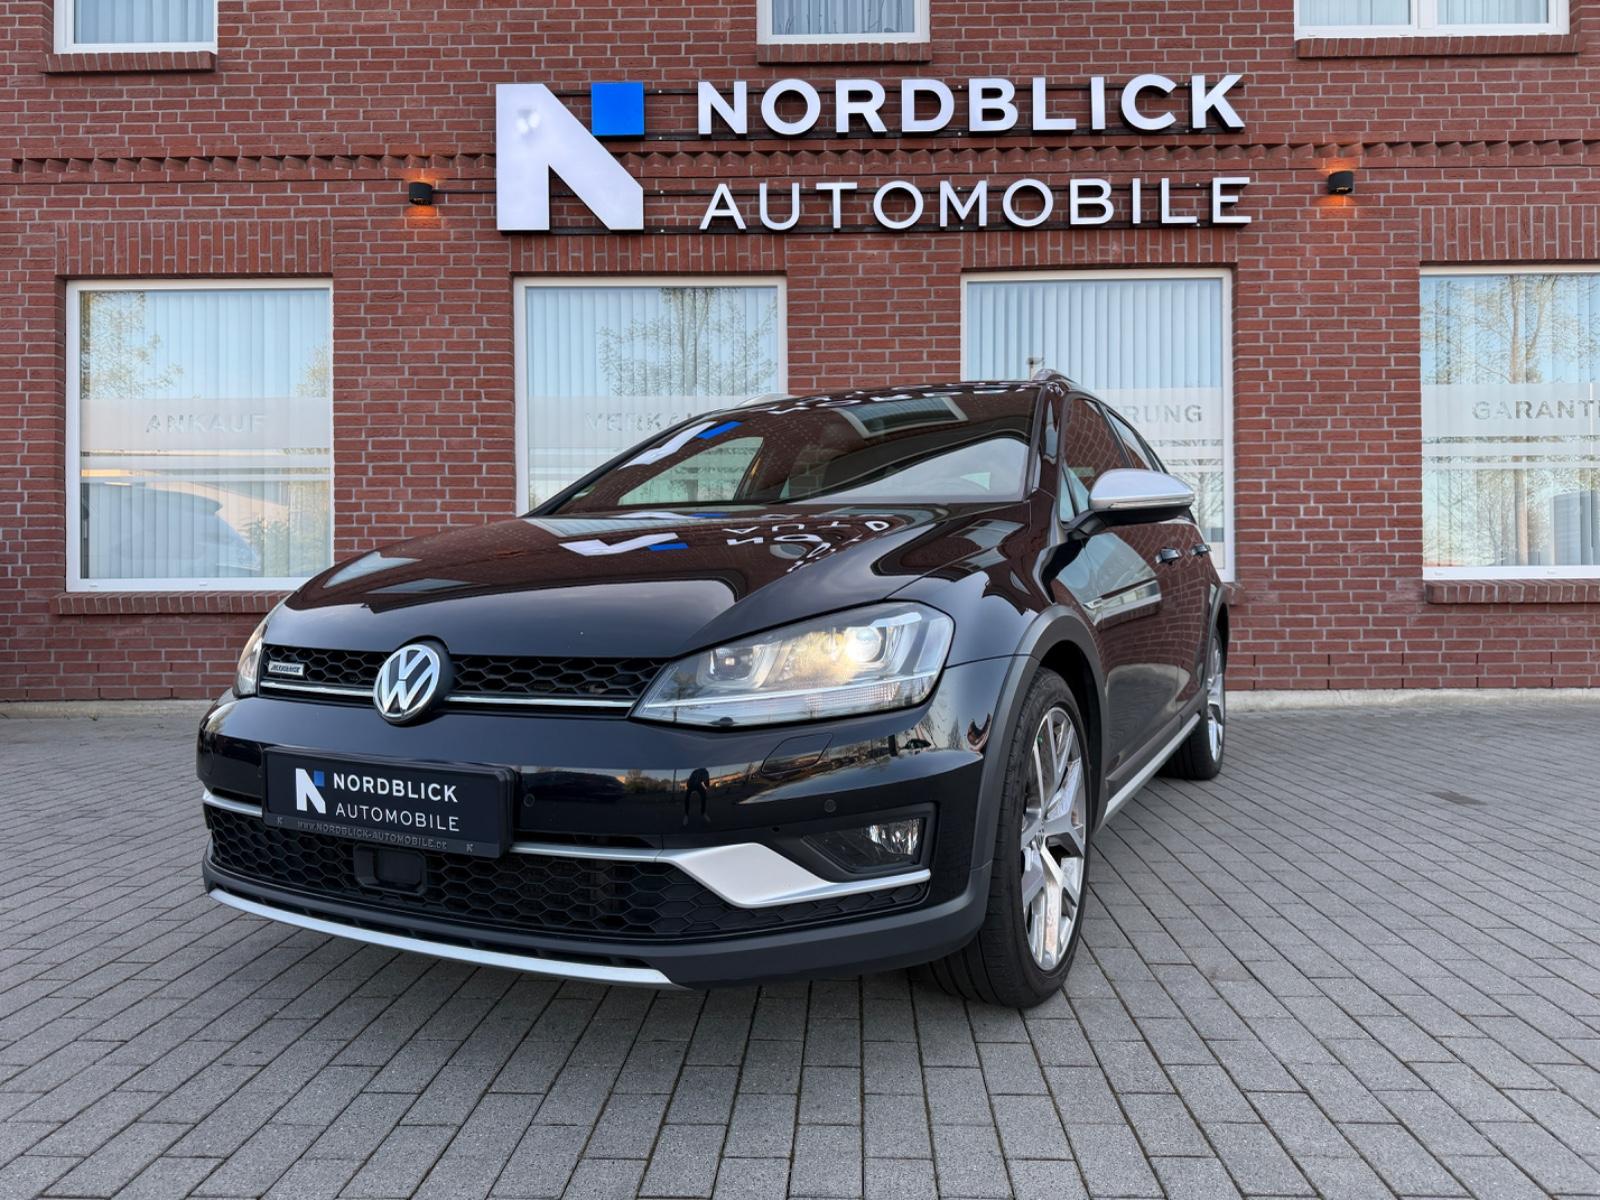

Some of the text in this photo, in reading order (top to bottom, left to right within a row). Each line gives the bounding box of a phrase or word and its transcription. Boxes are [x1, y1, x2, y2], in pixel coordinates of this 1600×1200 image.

[697, 73, 1245, 136] NORDBLICK
[699, 176, 1252, 231] AUTOMOBILE
[145, 413, 266, 434] ANKAUF
[333, 772, 458, 803] NORDBLICK
[335, 802, 460, 832] AUTOMOBILE
